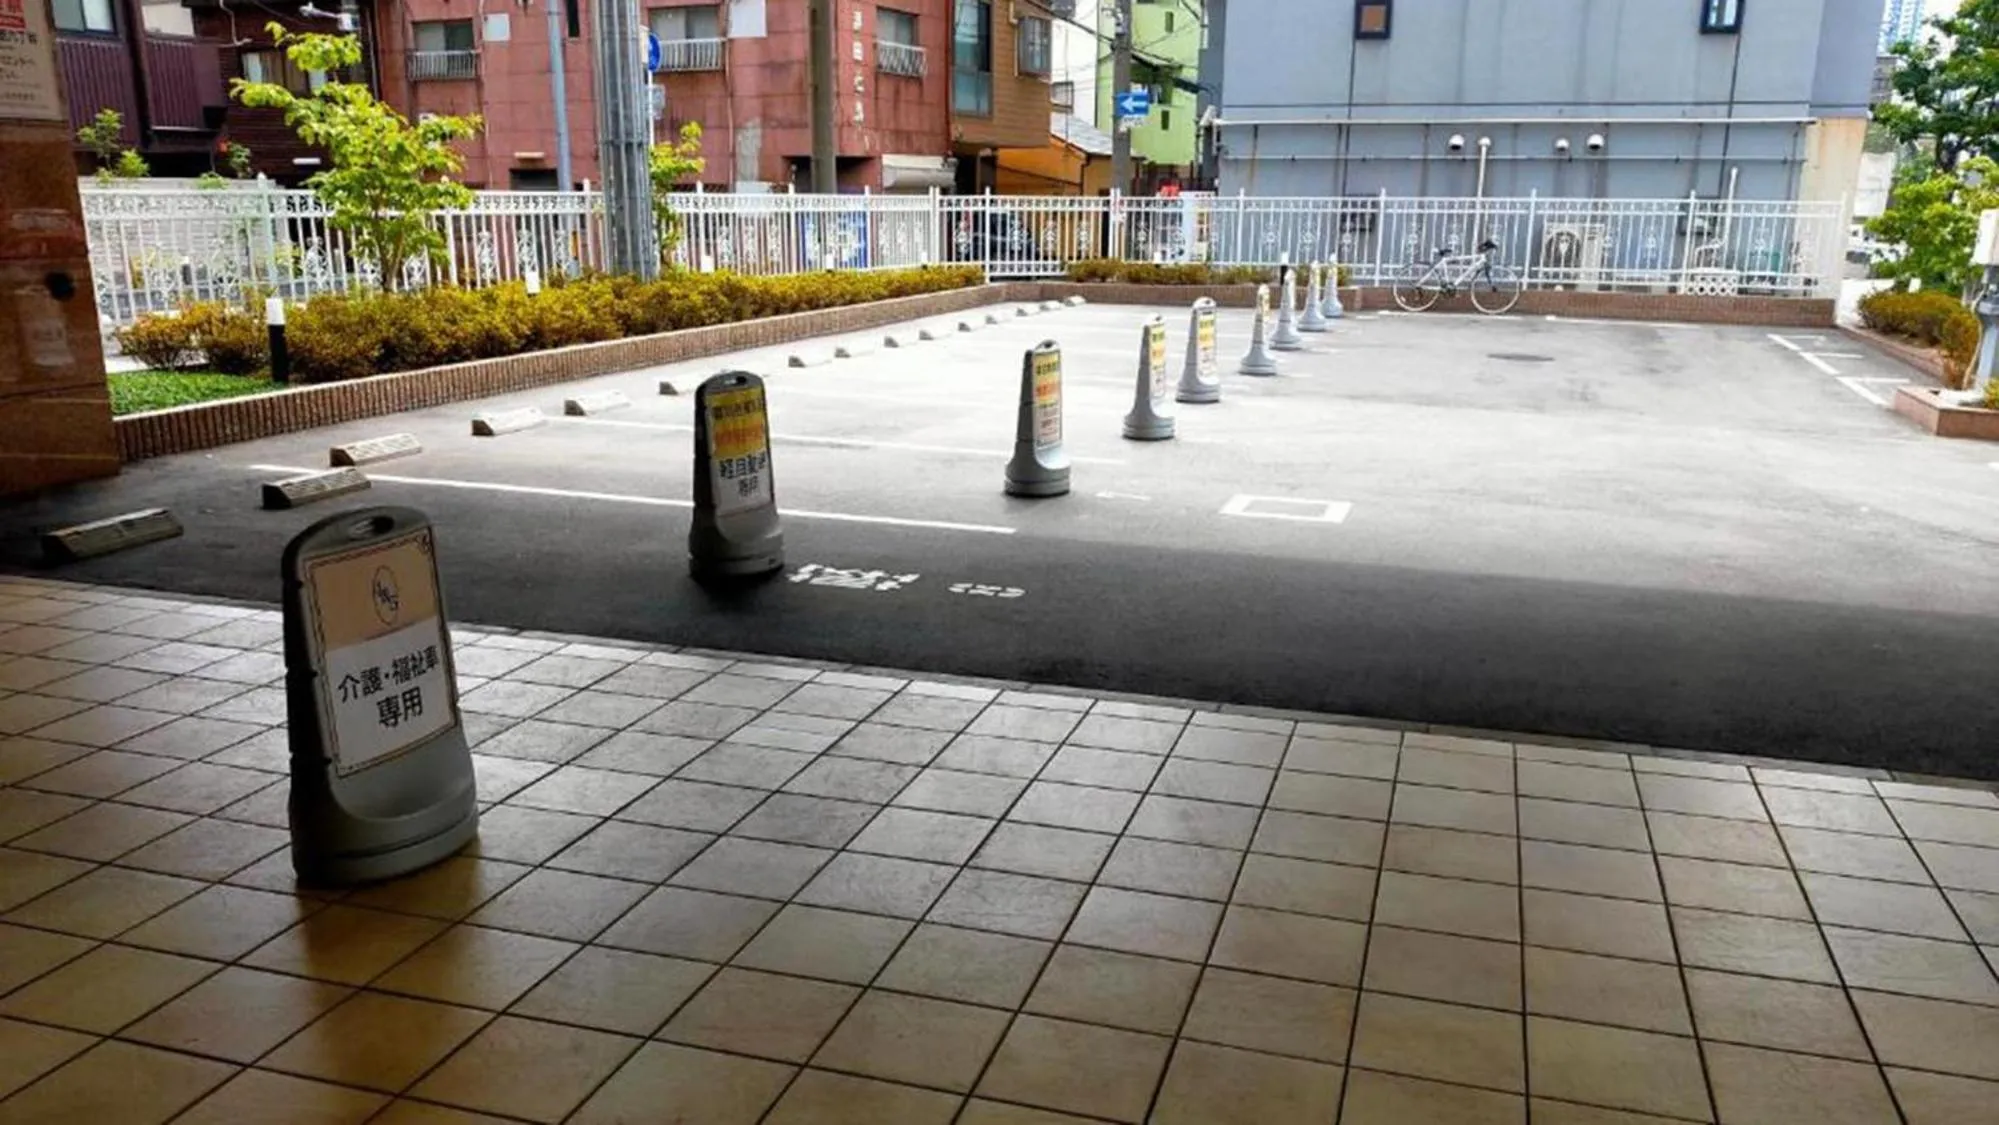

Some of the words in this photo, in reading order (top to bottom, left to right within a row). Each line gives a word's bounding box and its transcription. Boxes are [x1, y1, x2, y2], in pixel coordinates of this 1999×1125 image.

[337, 645, 438, 702] 介護・福祉車
[376, 686, 423, 728] 専用
